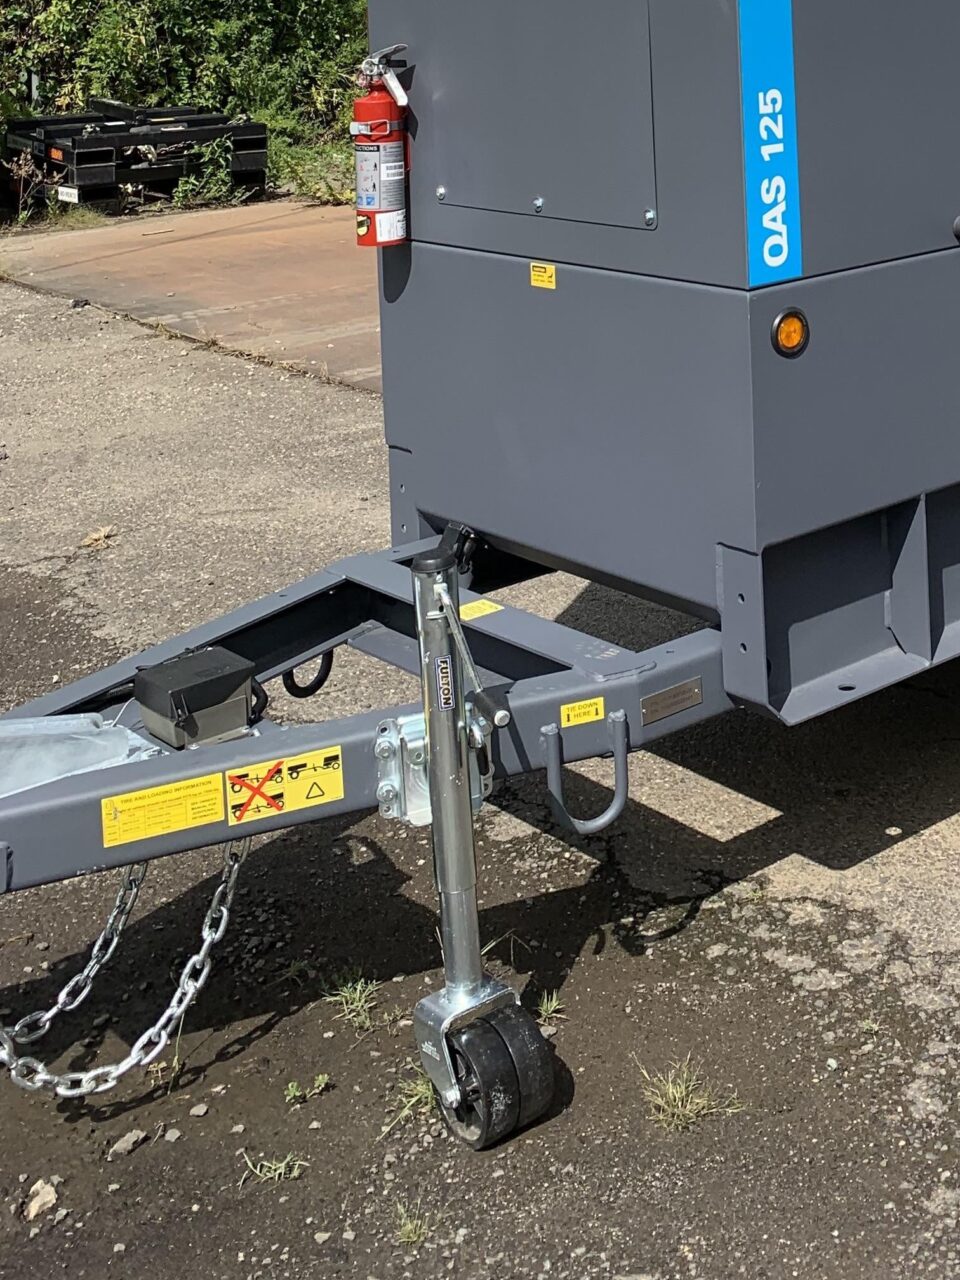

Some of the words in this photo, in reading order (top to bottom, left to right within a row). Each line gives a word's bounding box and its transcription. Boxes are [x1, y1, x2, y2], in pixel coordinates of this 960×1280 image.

[758, 88, 785, 162] 125
[760, 175, 789, 268] QAS
[439, 660, 452, 707] FULTON
[578, 702, 599, 711] DOWN
[573, 710, 591, 719] HERE
